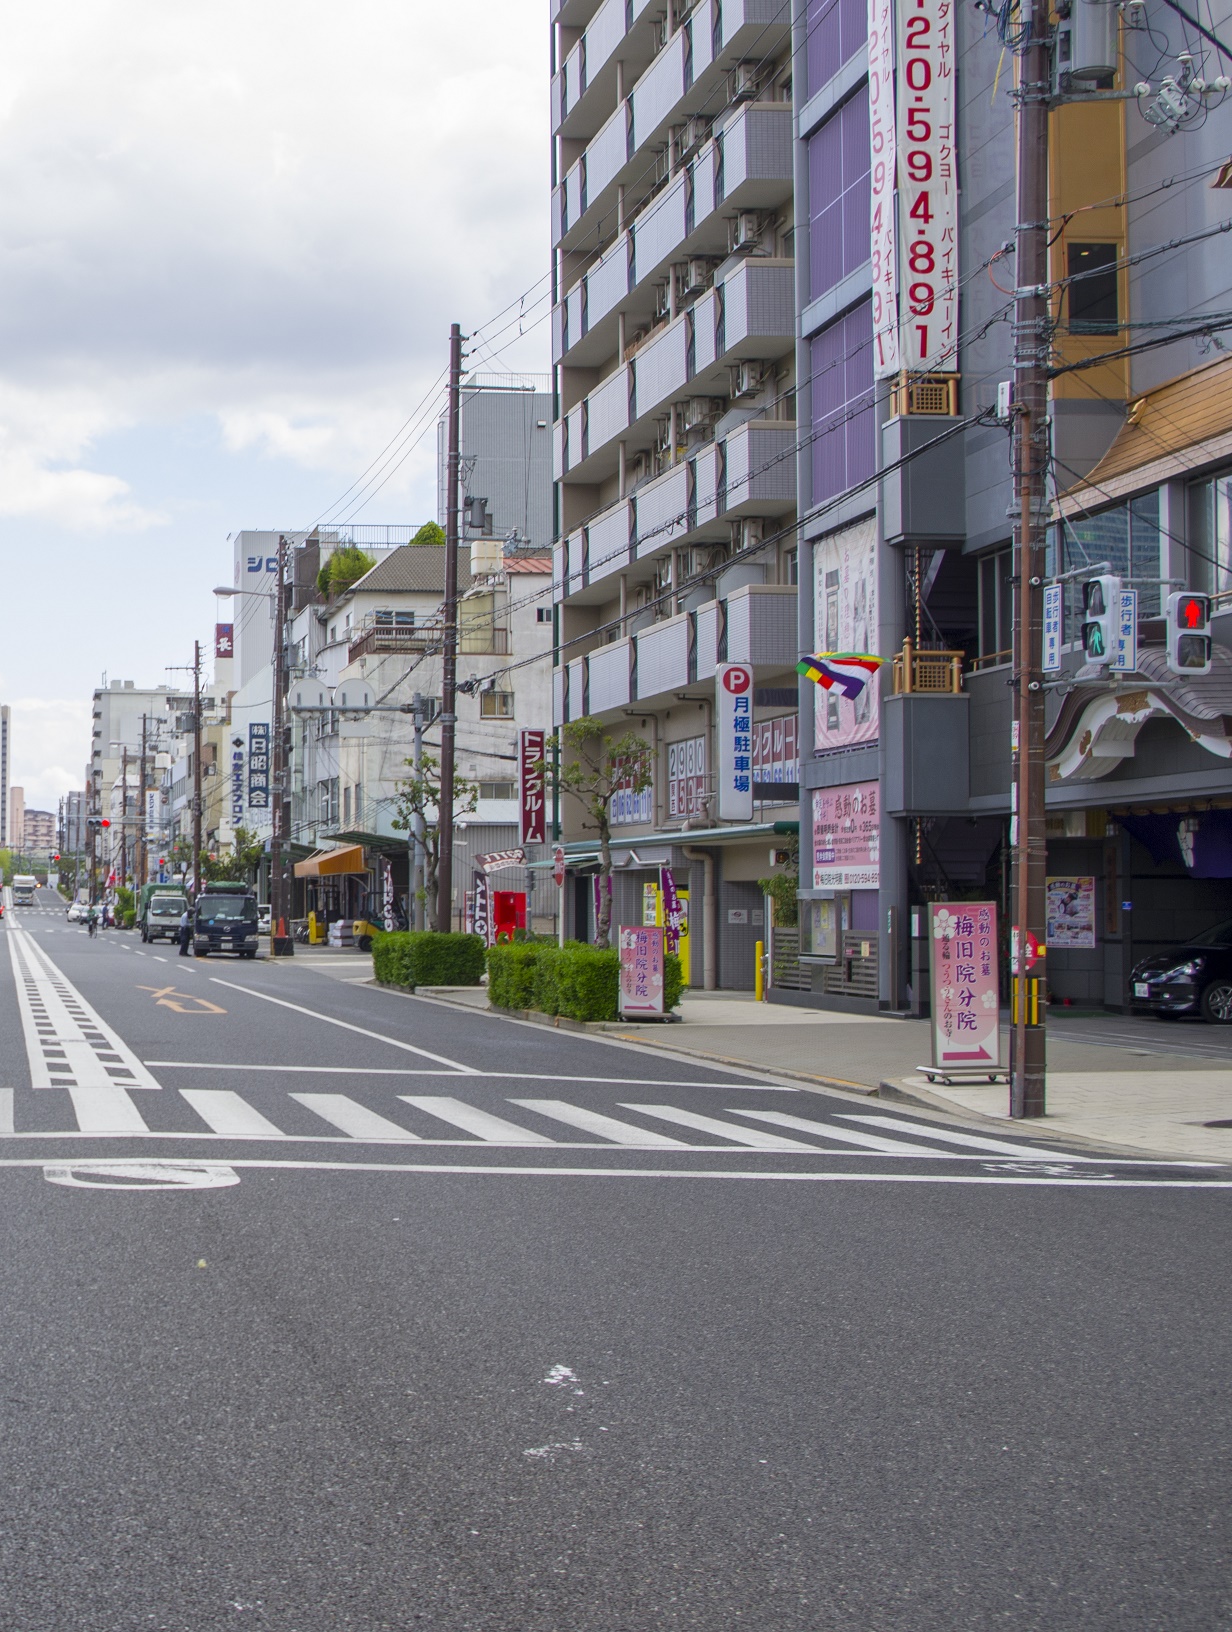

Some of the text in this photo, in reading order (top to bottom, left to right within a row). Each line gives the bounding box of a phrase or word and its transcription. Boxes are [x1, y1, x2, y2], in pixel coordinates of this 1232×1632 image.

[1120, 595, 1133, 636] 歩行者
[1048, 637, 1056, 665] 専用
[730, 671, 745, 691] P
[670, 741, 703, 777] 2980
[733, 697, 751, 793] 月極駐車場
[753, 728, 799, 758] ンクルー
[525, 732, 542, 843] トランクルーム
[635, 931, 649, 997] 梅旧院分院
[978, 908, 991, 977] 感動のお墓
[954, 915, 978, 1031] 梅旧院分院
